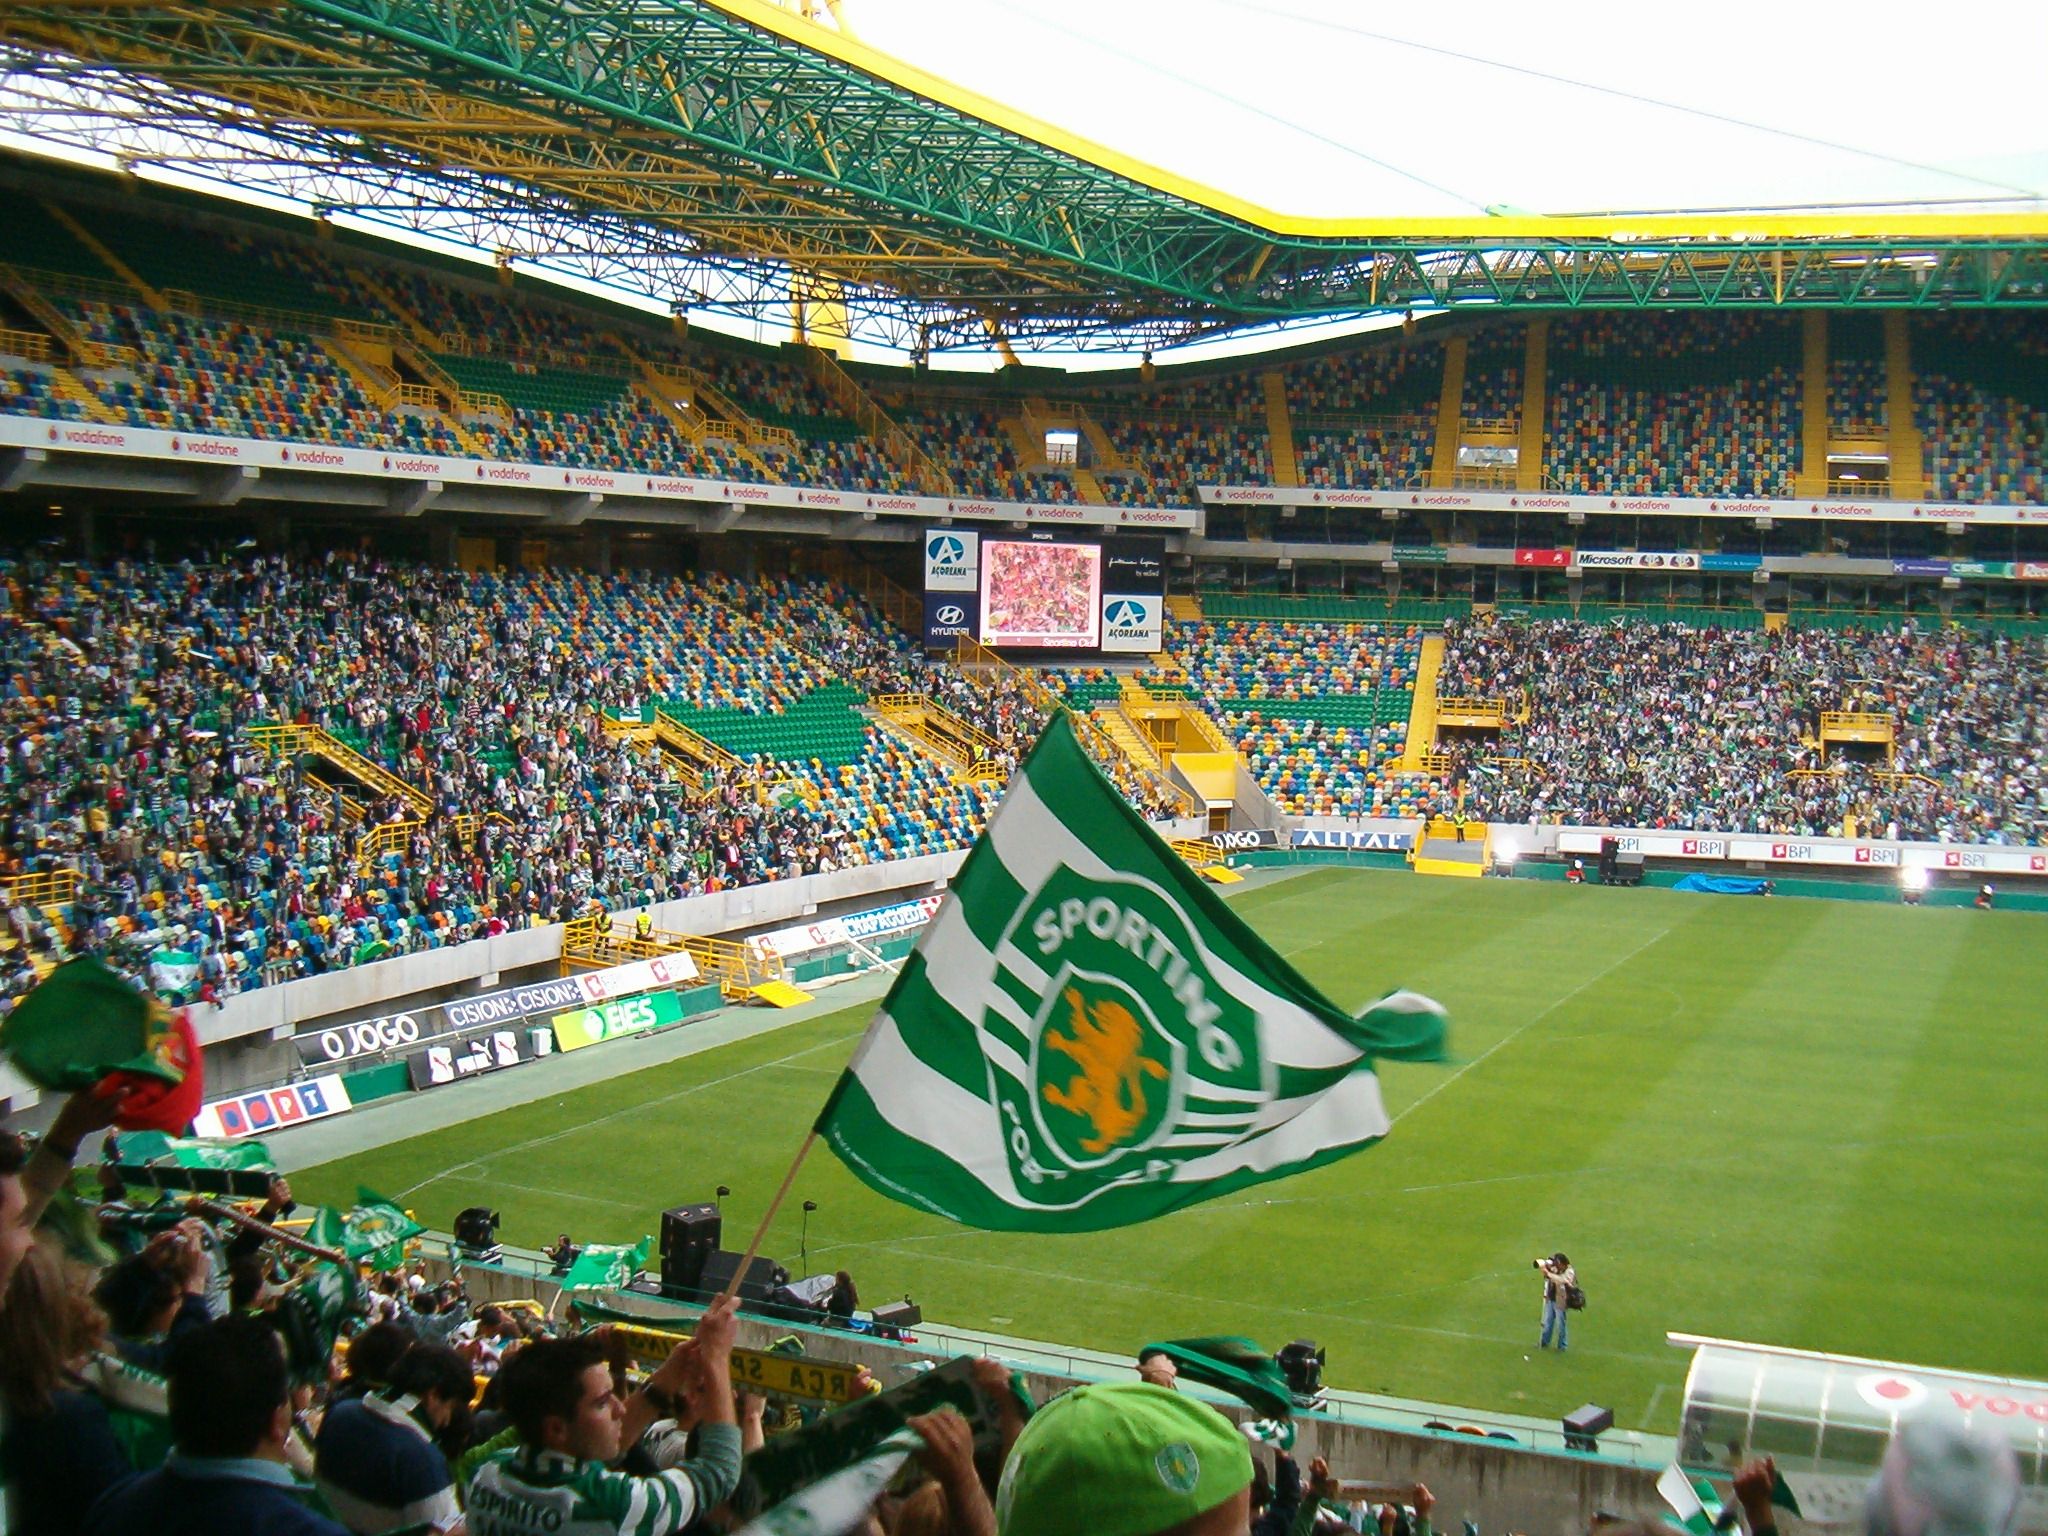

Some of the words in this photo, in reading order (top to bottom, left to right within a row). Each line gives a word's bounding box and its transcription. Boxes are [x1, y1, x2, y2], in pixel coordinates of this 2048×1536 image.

[65, 429, 125, 447] vodafone
[186, 439, 240, 456] vodafone
[295, 450, 344, 465] vodafone
[395, 458, 440, 473] vodafone
[488, 466, 531, 481] vodafone
[575, 473, 615, 487] vodafone
[656, 481, 694, 494] vodafone
[733, 487, 769, 499] vodafone
[807, 492, 841, 505] vodafone
[1227, 490, 1275, 500] vodafone
[1326, 493, 1372, 503] vodafone
[1423, 495, 1471, 505] vodafone
[877, 498, 917, 510] vodafone
[957, 503, 995, 515] vodafone
[1523, 498, 1570, 508] vodafone
[1623, 500, 1670, 510] vodafone
[1722, 502, 1771, 512] vodafone
[1038, 508, 1083, 519] vodafone
[1132, 510, 1177, 522] vodafone
[1824, 505, 1873, 515] vodafone
[1926, 508, 1975, 517] vodafone
[1579, 554, 1634, 566] Microsoft
[931, 566, 967, 577] AÇOREANA
[1108, 628, 1149, 639] AÇOREANA
[1617, 837, 1640, 852] BPI
[1699, 840, 1722, 854] BPI
[1789, 845, 1812, 859] BPI
[1872, 848, 1896, 863] BPI
[1962, 853, 1985, 867] BPI
[1033, 897, 1244, 1071] SPORTING
[517, 984, 573, 1011] CISION
[450, 997, 507, 1027] CISION
[321, 1031, 344, 1059] O
[349, 1015, 419, 1056] JOGO
